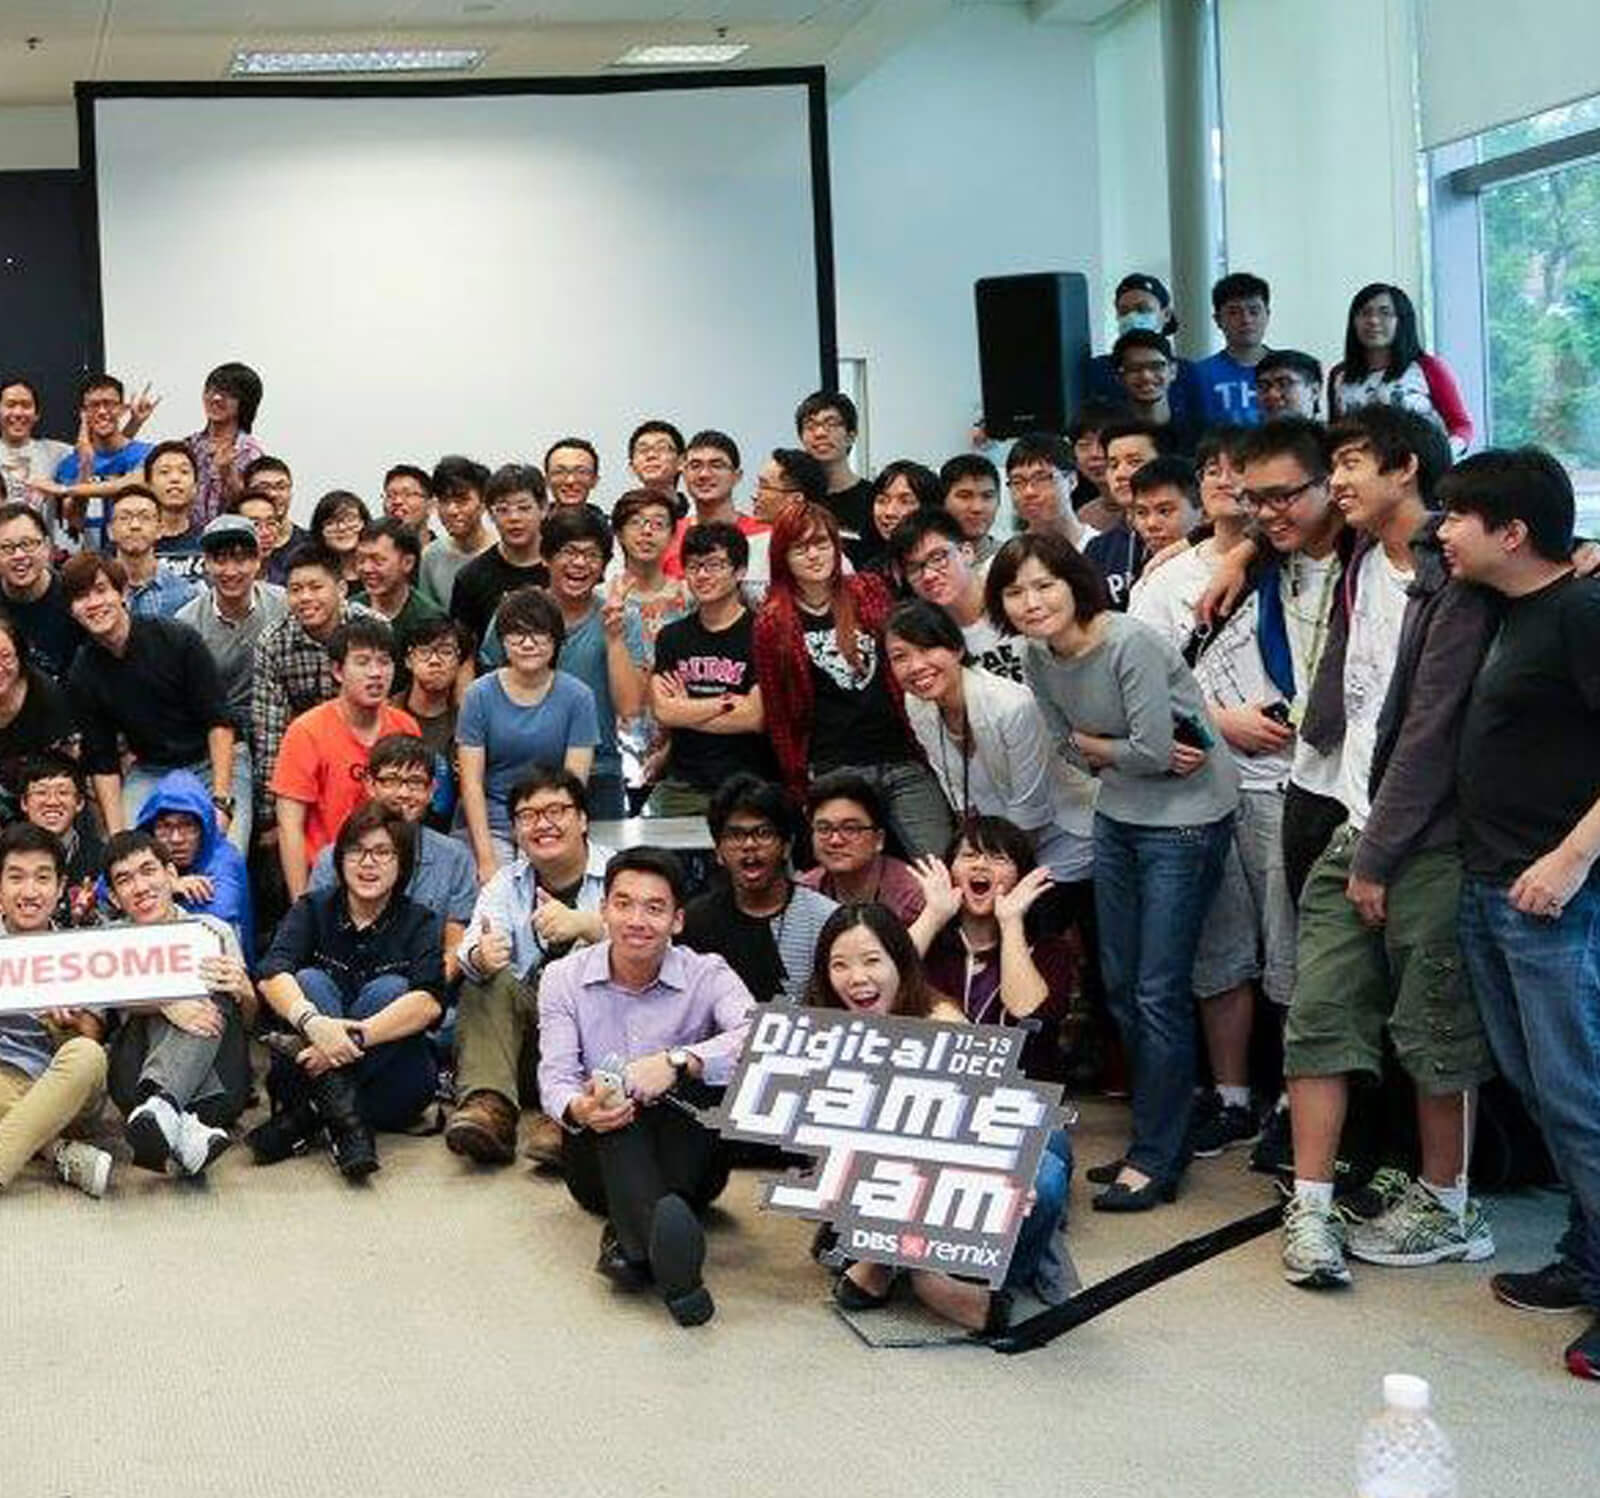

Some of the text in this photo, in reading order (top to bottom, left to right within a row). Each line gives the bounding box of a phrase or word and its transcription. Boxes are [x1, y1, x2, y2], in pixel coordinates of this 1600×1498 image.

[752, 1012, 952, 1071] Digital
[948, 1053, 1005, 1078] DEC
[729, 1053, 1048, 1147] Game
[770, 1125, 1024, 1233] Jam
[852, 1229, 1001, 1267] DBS remix
